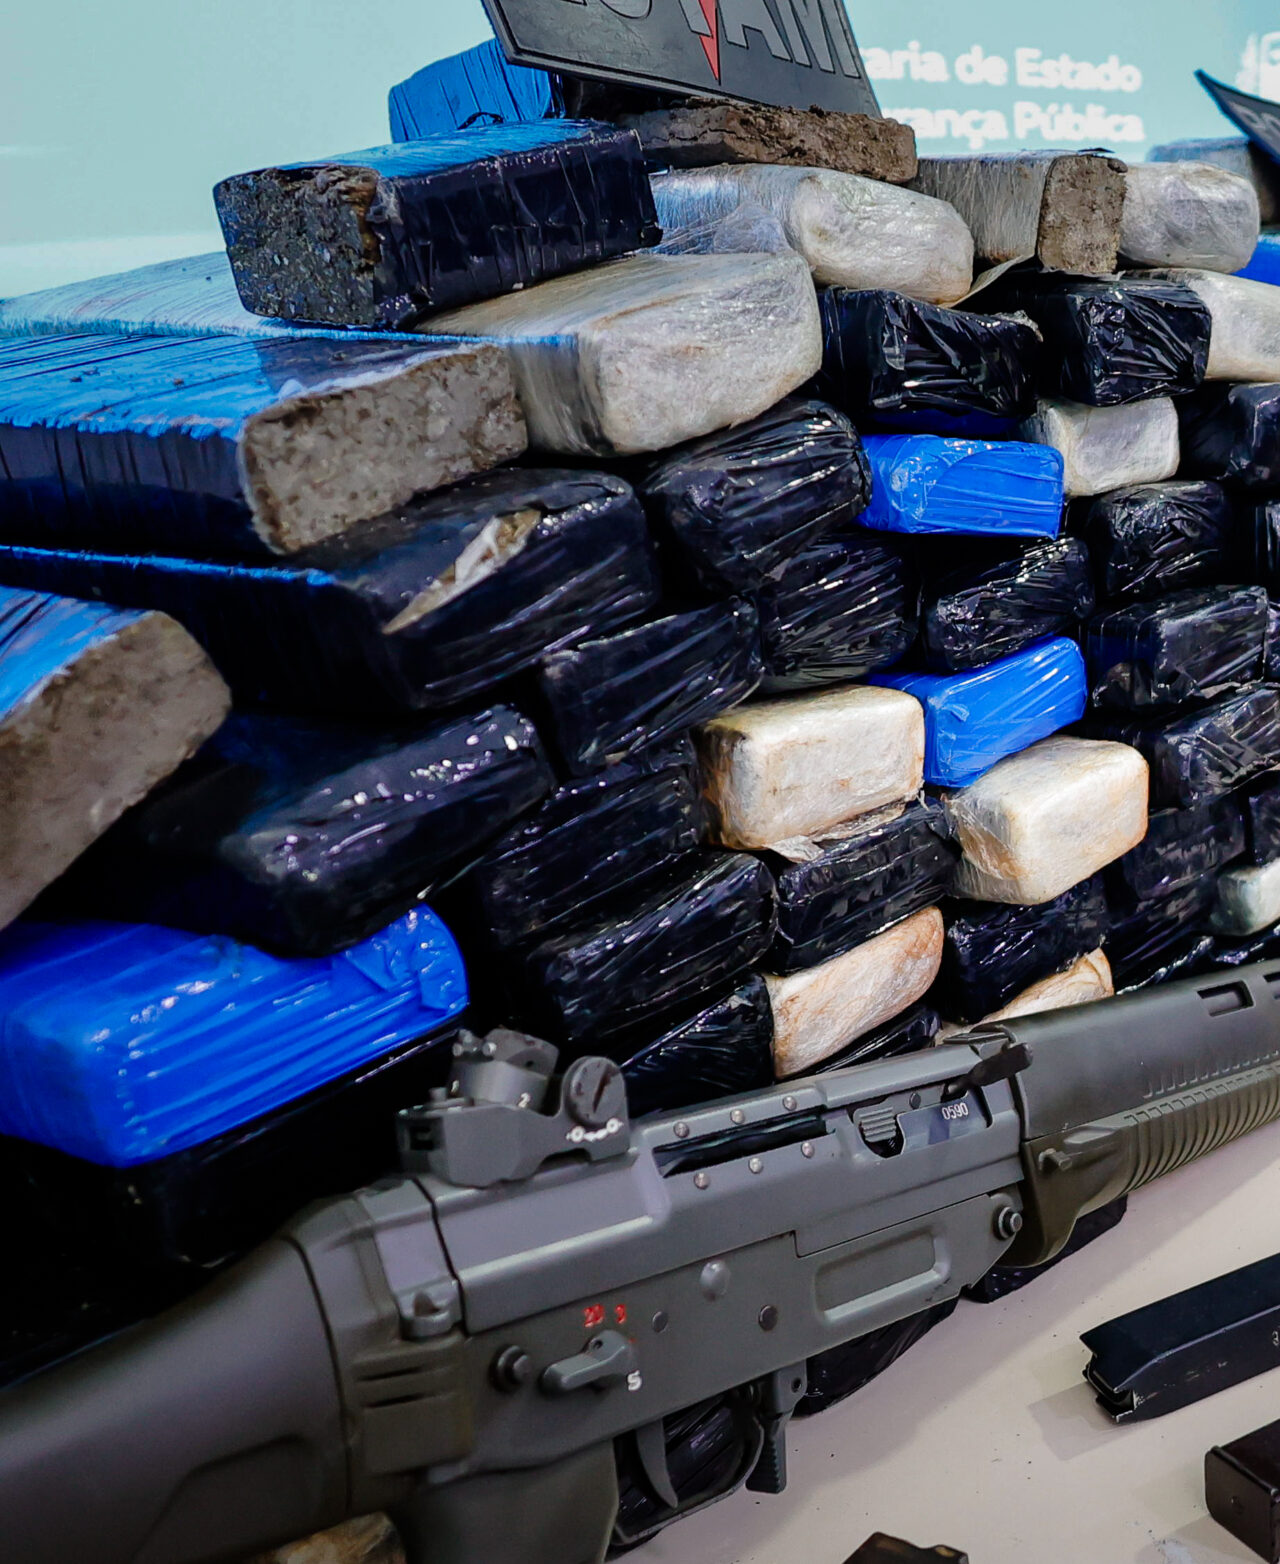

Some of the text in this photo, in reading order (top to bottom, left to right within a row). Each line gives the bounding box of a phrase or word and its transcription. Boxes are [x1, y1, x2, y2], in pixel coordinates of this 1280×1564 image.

[858, 40, 949, 83] aria
[954, 44, 1009, 86] de
[1014, 48, 1144, 93] Estado
[882, 101, 1146, 150] rança Pública
[941, 1102, 969, 1120] 0590
